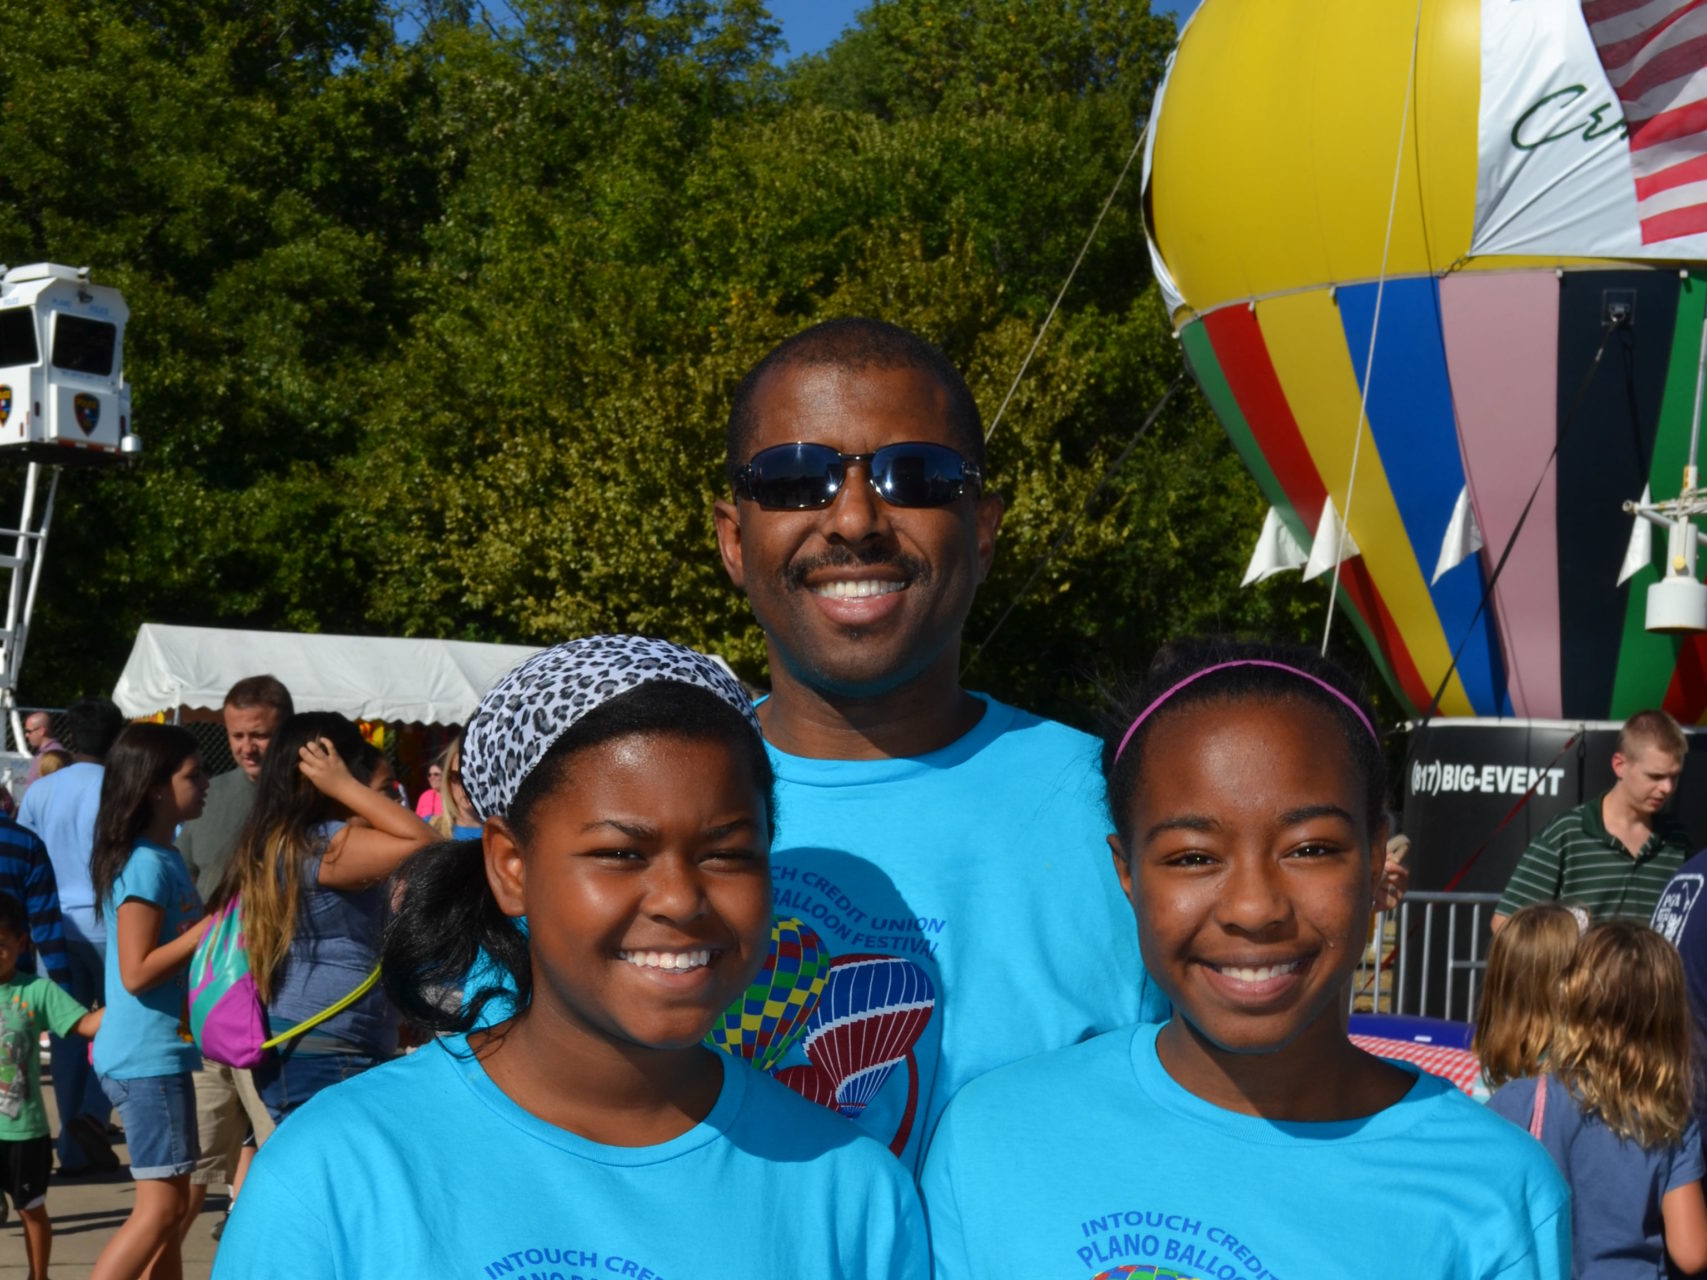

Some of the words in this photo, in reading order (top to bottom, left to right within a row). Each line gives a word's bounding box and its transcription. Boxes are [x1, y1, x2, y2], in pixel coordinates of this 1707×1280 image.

[800, 871, 868, 924] CREDIT
[871, 917, 947, 934] UNION
[852, 934, 940, 962] FESTIVAL
[1081, 1211, 1202, 1238] INTOUCH
[484, 1247, 598, 1280] INTOUCH
[1076, 1233, 1160, 1270] PLANO
